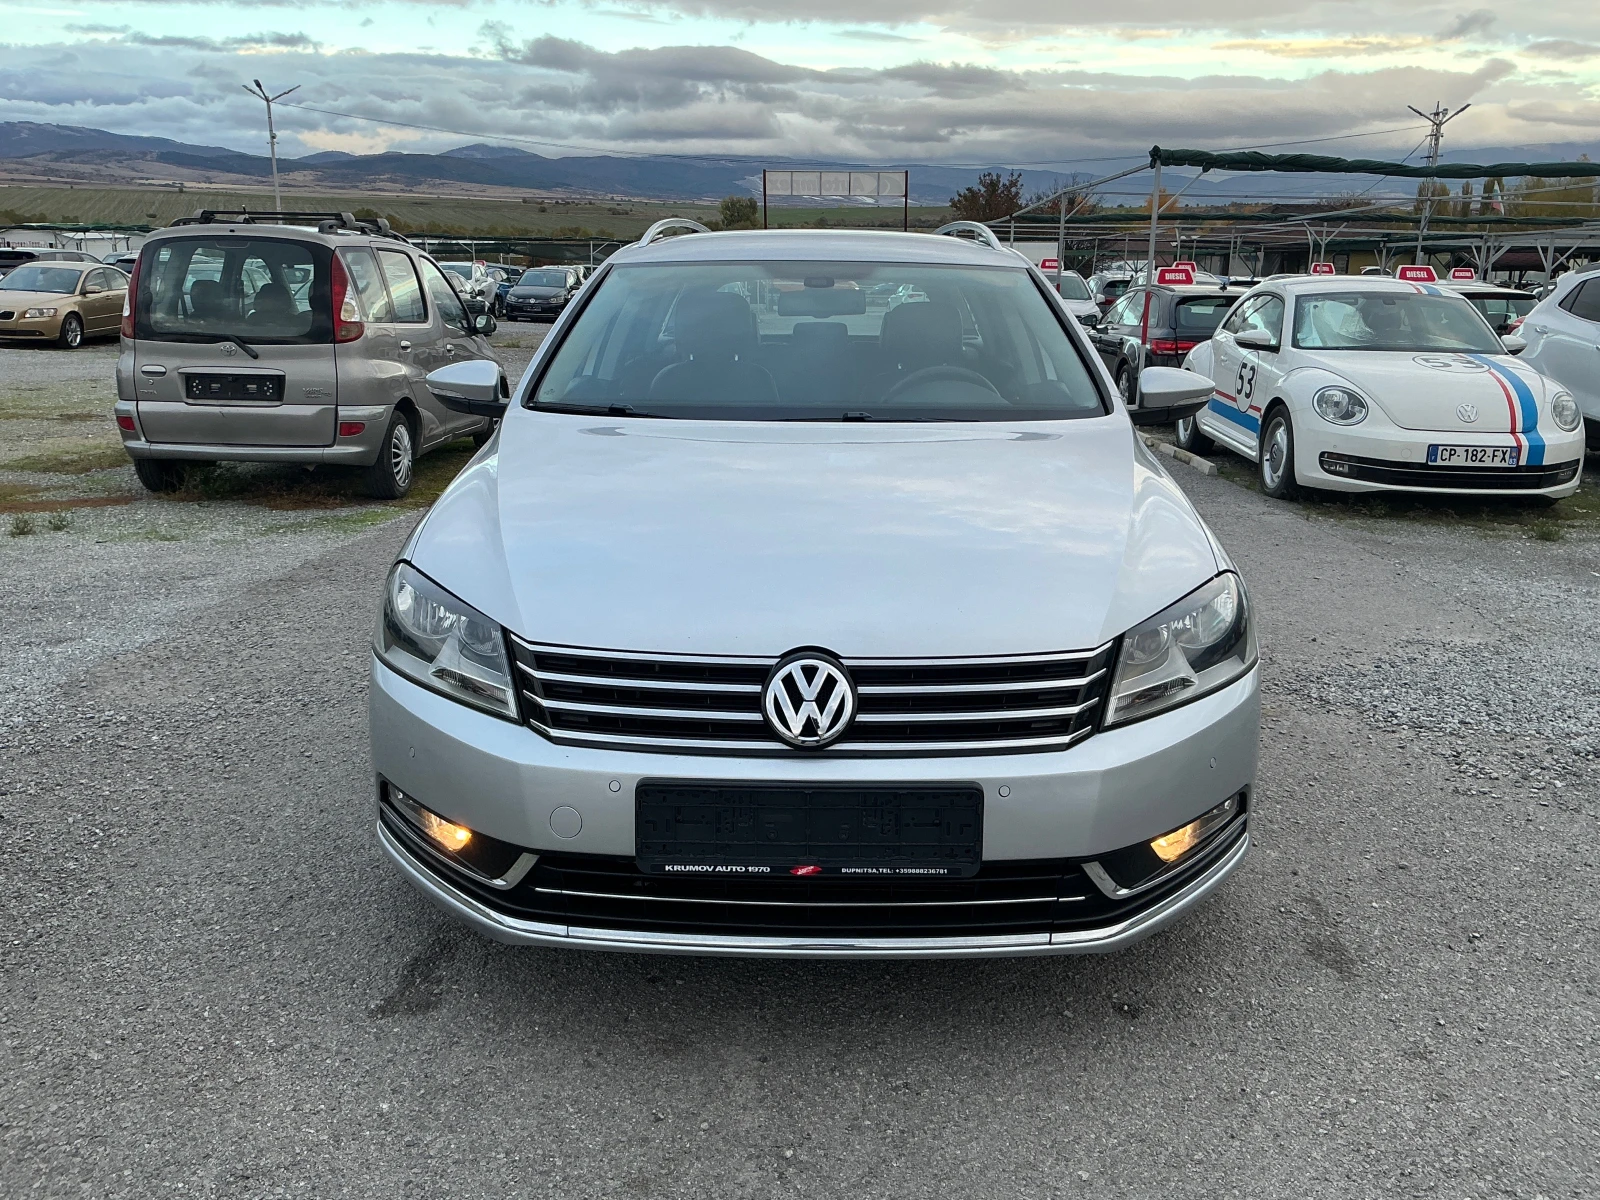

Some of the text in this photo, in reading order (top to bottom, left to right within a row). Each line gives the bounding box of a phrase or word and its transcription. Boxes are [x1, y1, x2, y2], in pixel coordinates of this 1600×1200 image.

[1236, 361, 1256, 399] 53
[1440, 447, 1508, 463] CP-182-FX
[767, 660, 852, 744] VW
